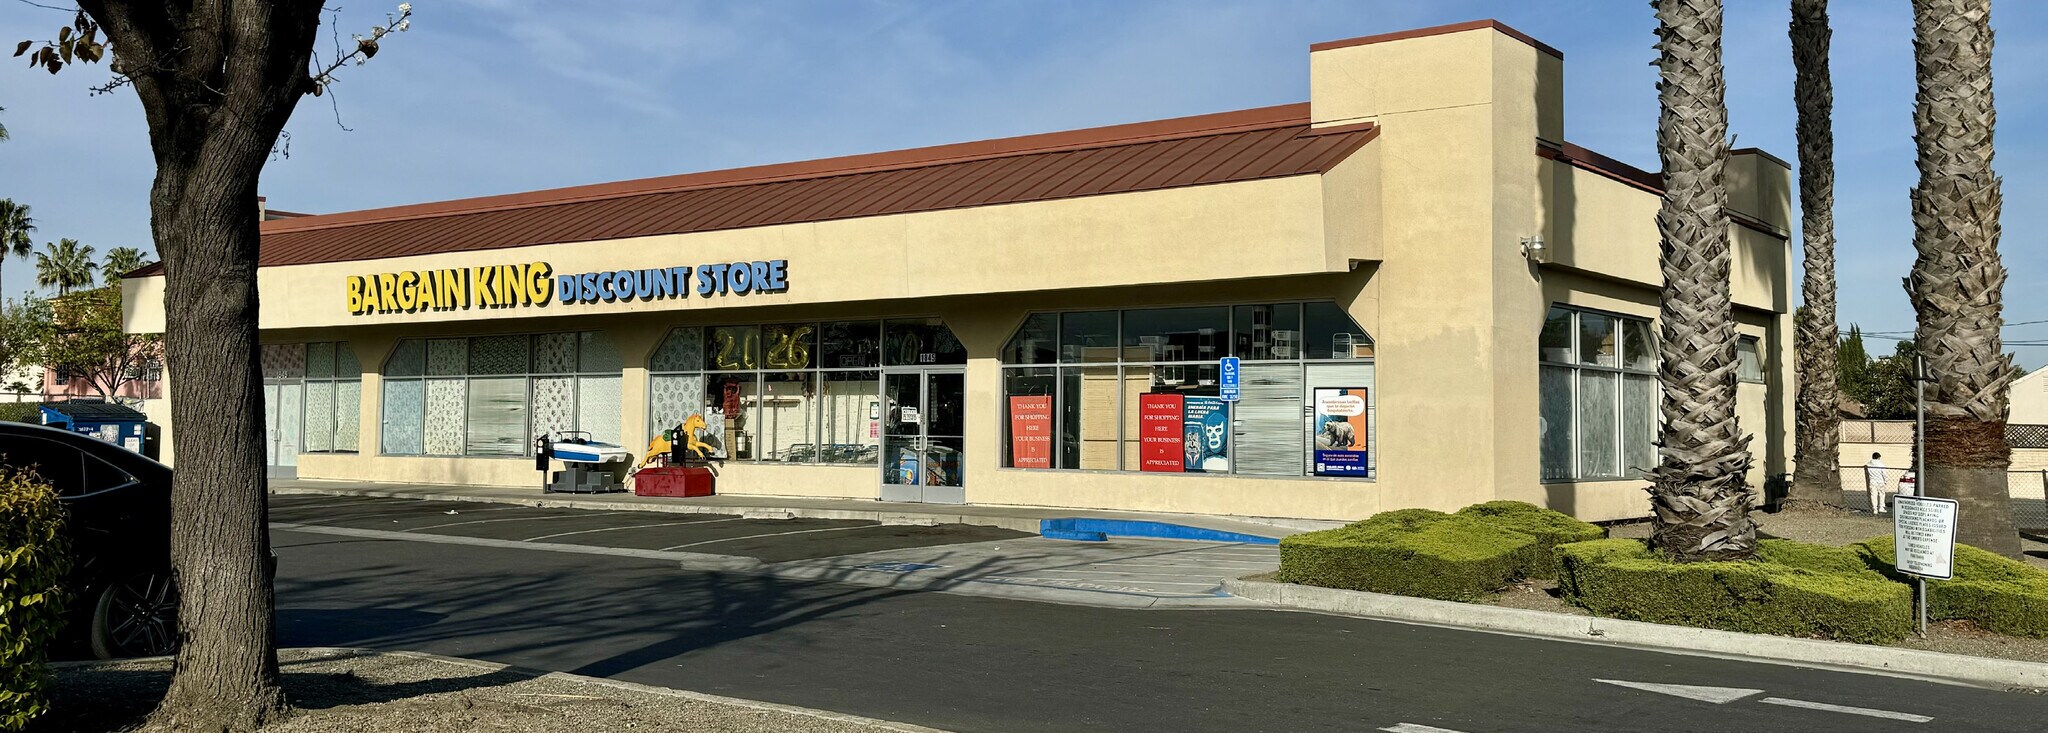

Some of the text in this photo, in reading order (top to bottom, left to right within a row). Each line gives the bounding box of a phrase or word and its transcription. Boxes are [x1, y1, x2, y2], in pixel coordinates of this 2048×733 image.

[347, 261, 554, 316] BARGAIN KING
[558, 259, 788, 305] DISCOUNT STORE
